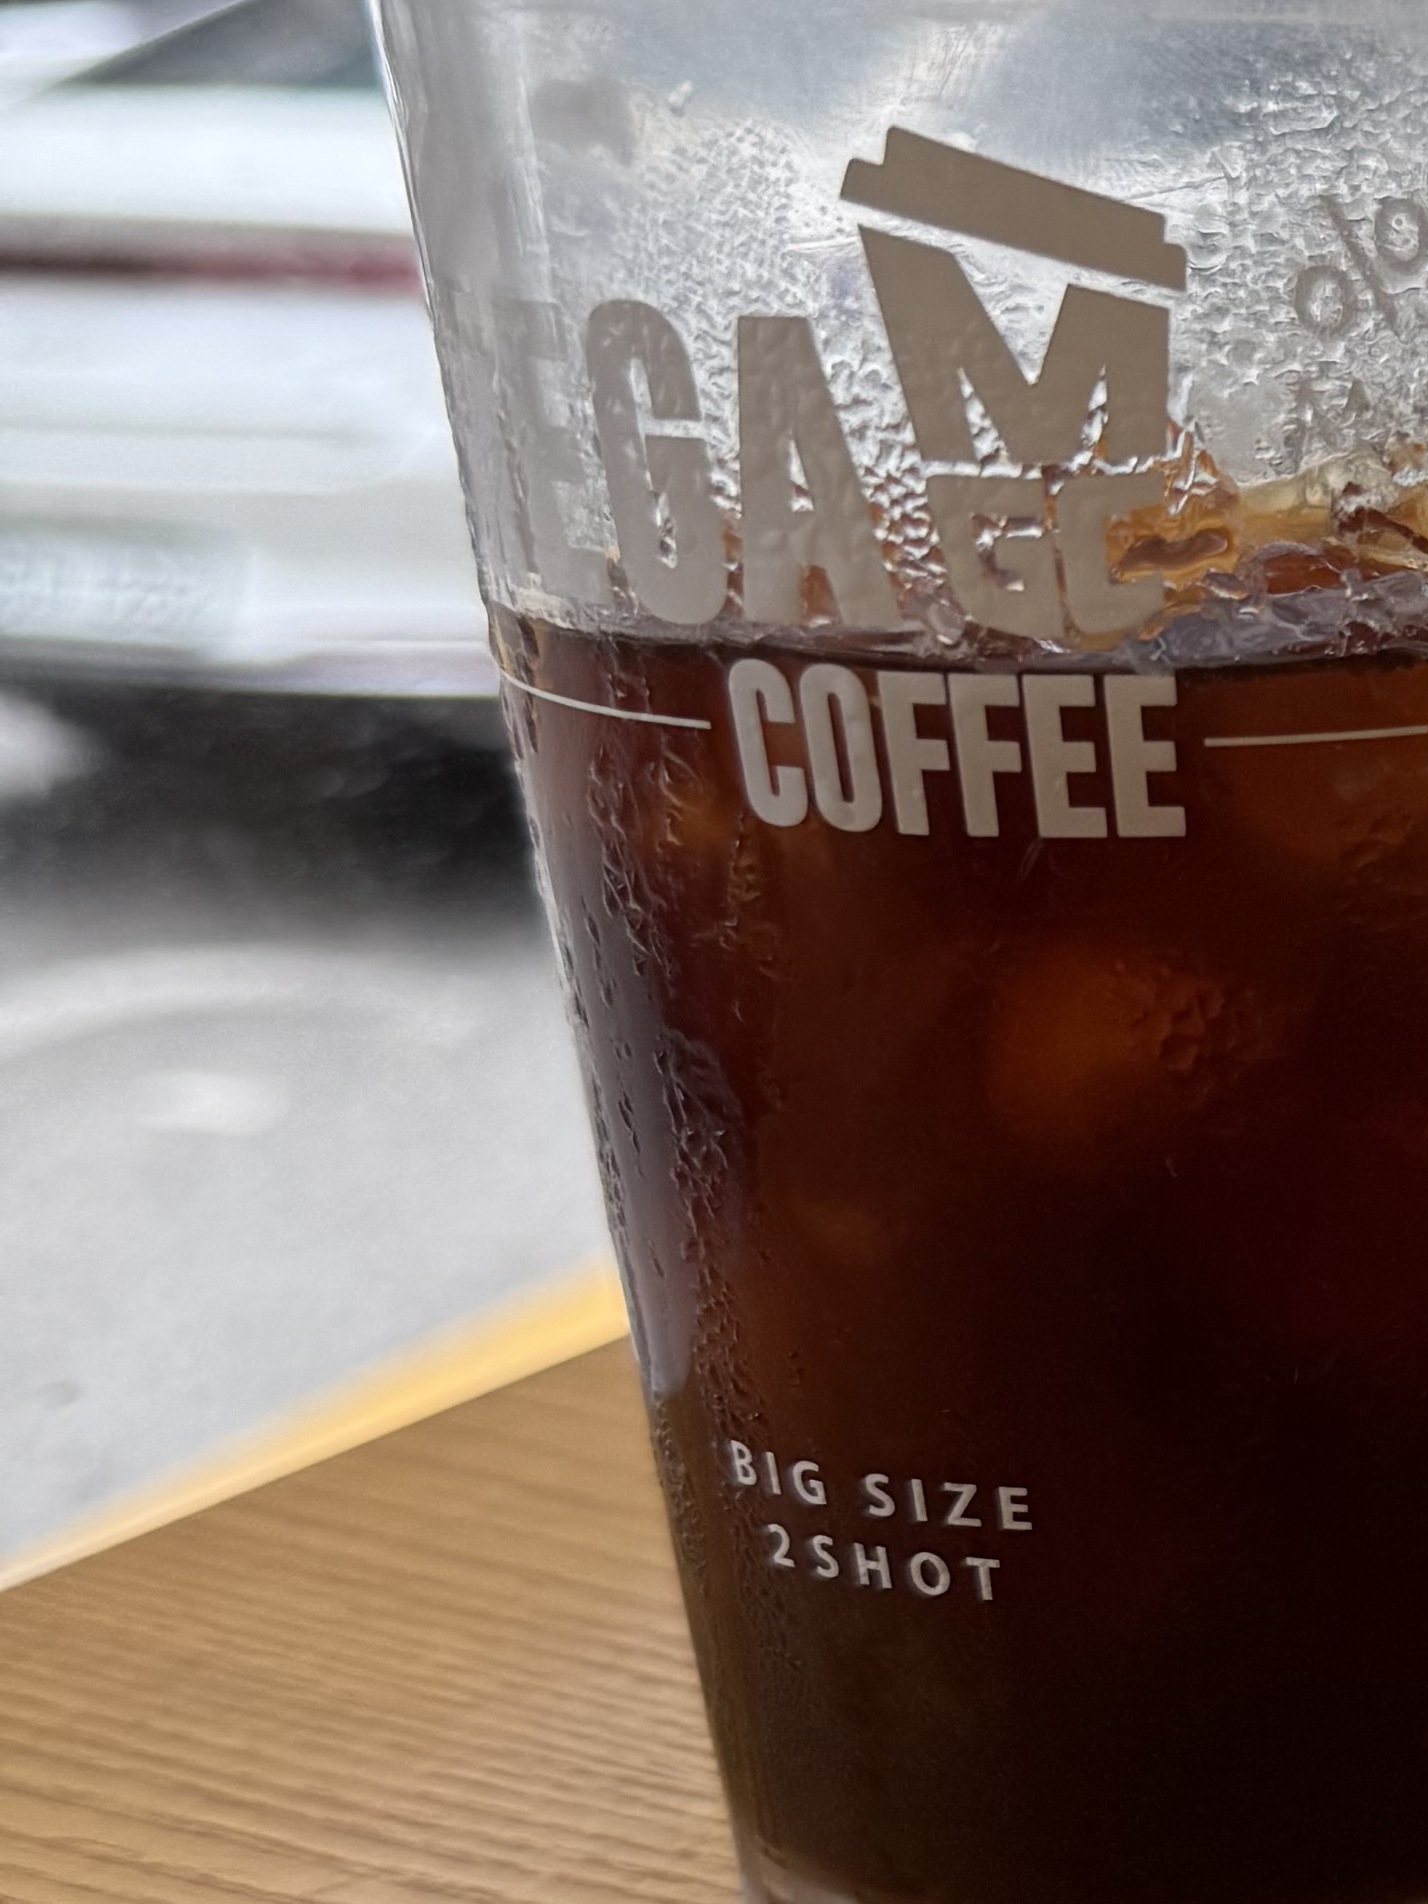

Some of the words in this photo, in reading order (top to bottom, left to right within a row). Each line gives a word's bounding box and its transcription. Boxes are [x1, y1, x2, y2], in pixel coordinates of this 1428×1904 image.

[726, 656, 1187, 839] COFFEE
[728, 1439, 828, 1507] BIG
[862, 1473, 1034, 1532] SIZE
[763, 1522, 1003, 1602] 2SHOT
